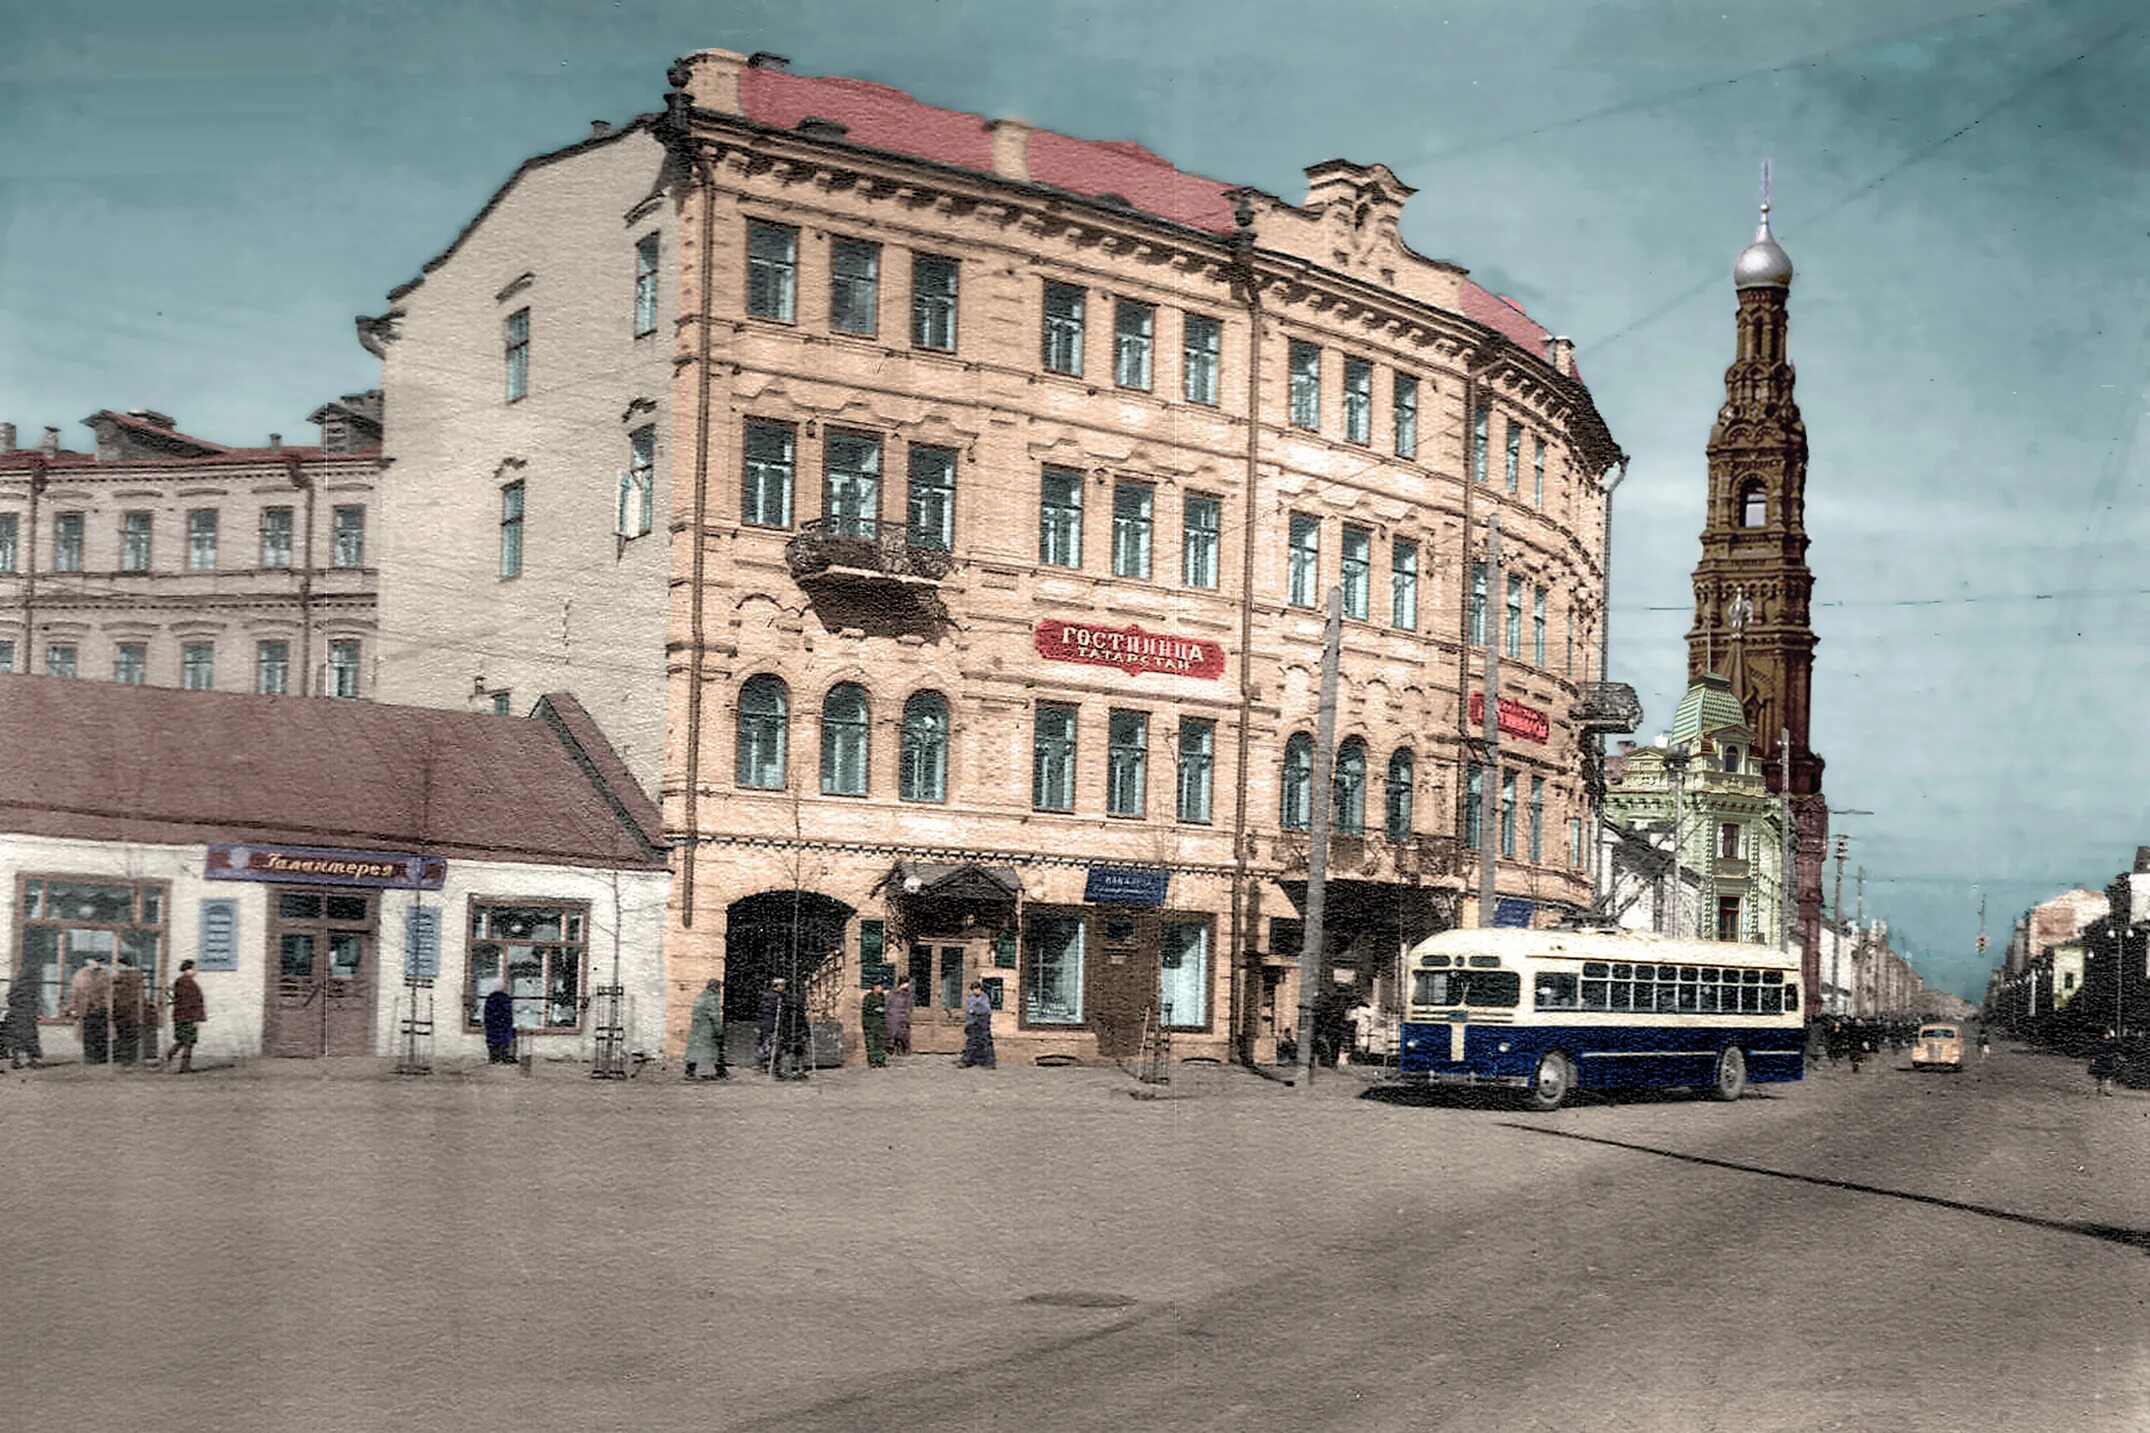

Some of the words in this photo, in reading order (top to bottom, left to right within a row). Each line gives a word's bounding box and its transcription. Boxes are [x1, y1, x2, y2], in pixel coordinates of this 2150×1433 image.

[1062, 627, 1204, 661] ГОСТИНИЦА
[1077, 645, 1190, 670] ТАТАРСТАН
[264, 853, 393, 880] Галантерея
